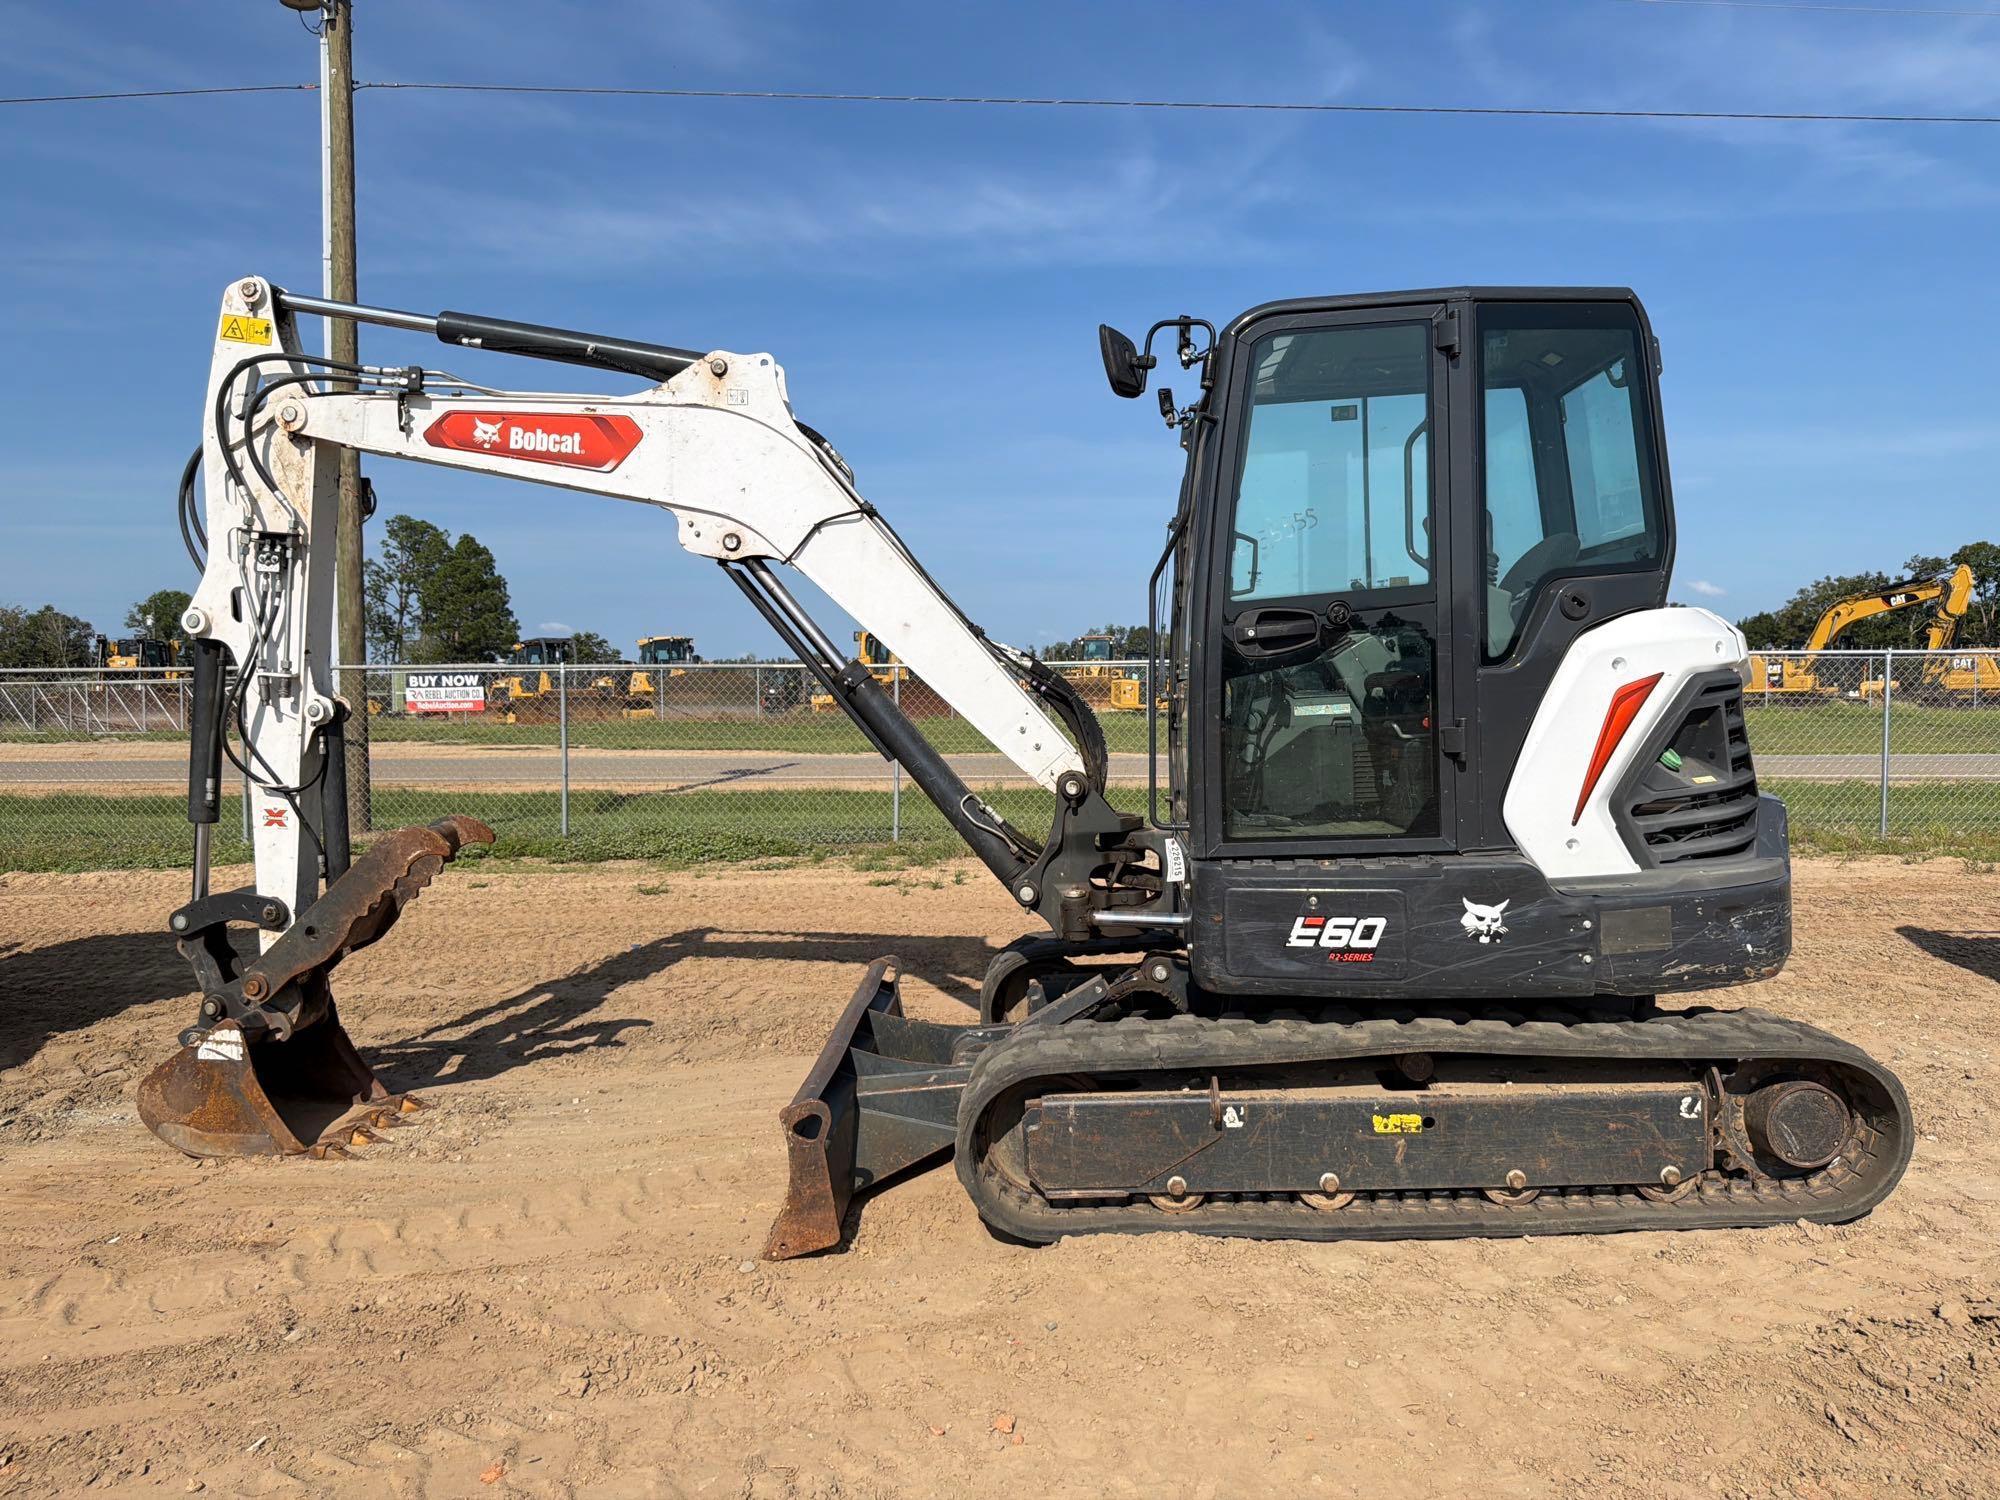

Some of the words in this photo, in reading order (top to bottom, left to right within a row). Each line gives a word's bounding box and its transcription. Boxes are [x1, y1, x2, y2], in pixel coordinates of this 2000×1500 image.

[509, 427, 582, 455] Bobcat
[1890, 594, 1906, 607] CAT
[1768, 664, 1782, 674] CAT
[1953, 658, 1972, 670] CAT
[409, 676, 438, 687] BUY
[442, 675, 479, 687] NOW
[425, 690, 442, 699] REBEL
[445, 690, 470, 699] AUCTION
[417, 701, 474, 710] RebelAuction.com
[1285, 916, 1388, 948] E60
[1329, 952, 1374, 962] R2-SERIES
